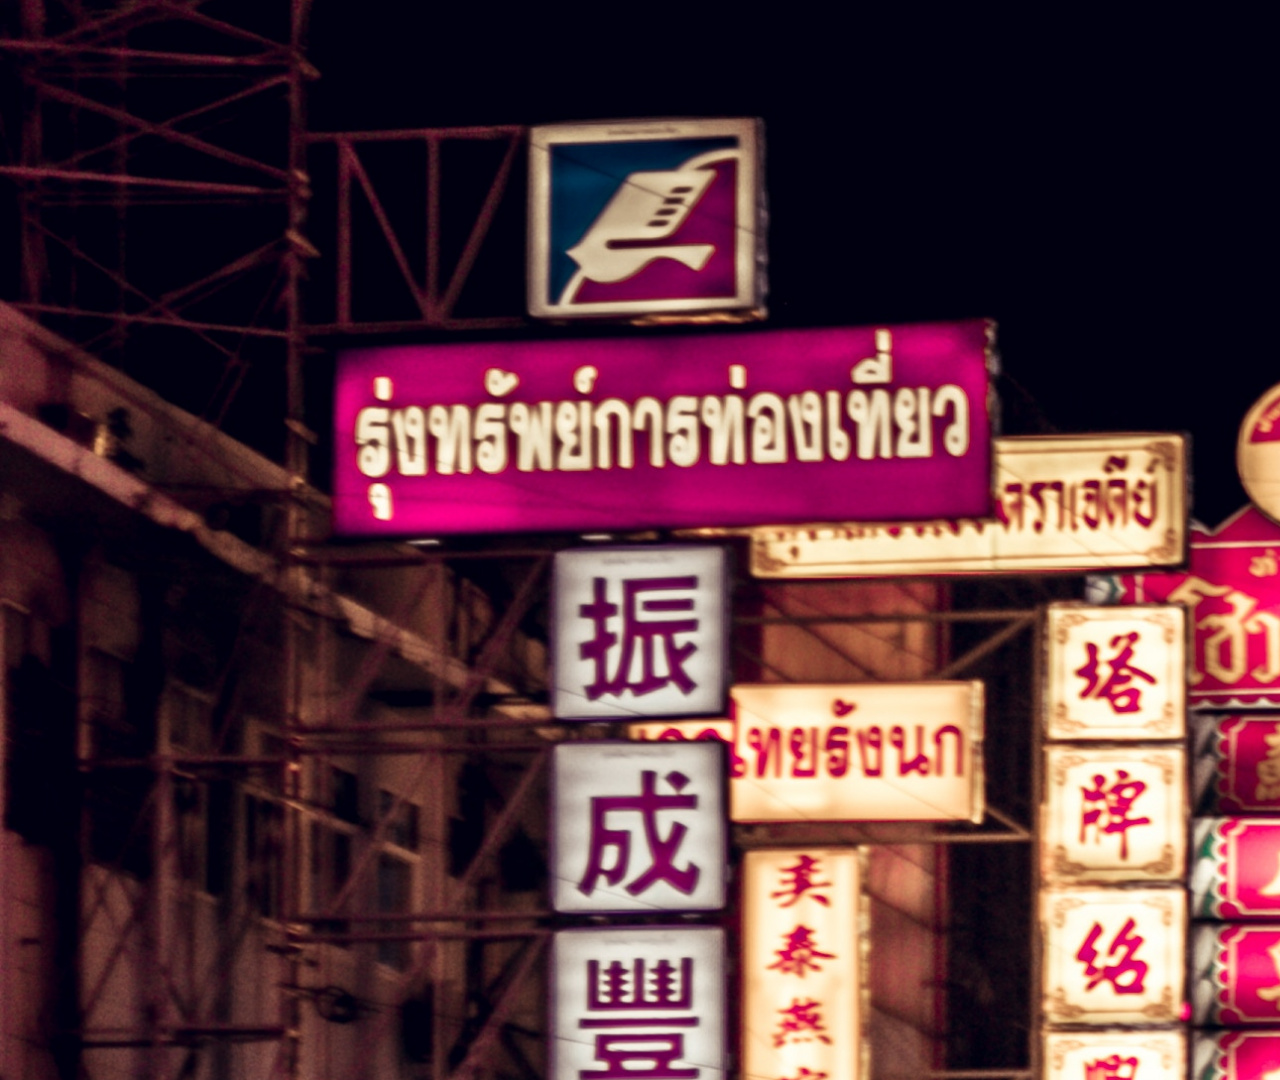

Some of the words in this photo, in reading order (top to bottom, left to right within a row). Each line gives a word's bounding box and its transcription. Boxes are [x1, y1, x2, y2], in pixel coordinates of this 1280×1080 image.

[354, 328, 971, 521] รุ่งทรัพย์การท่องเที่ยว
